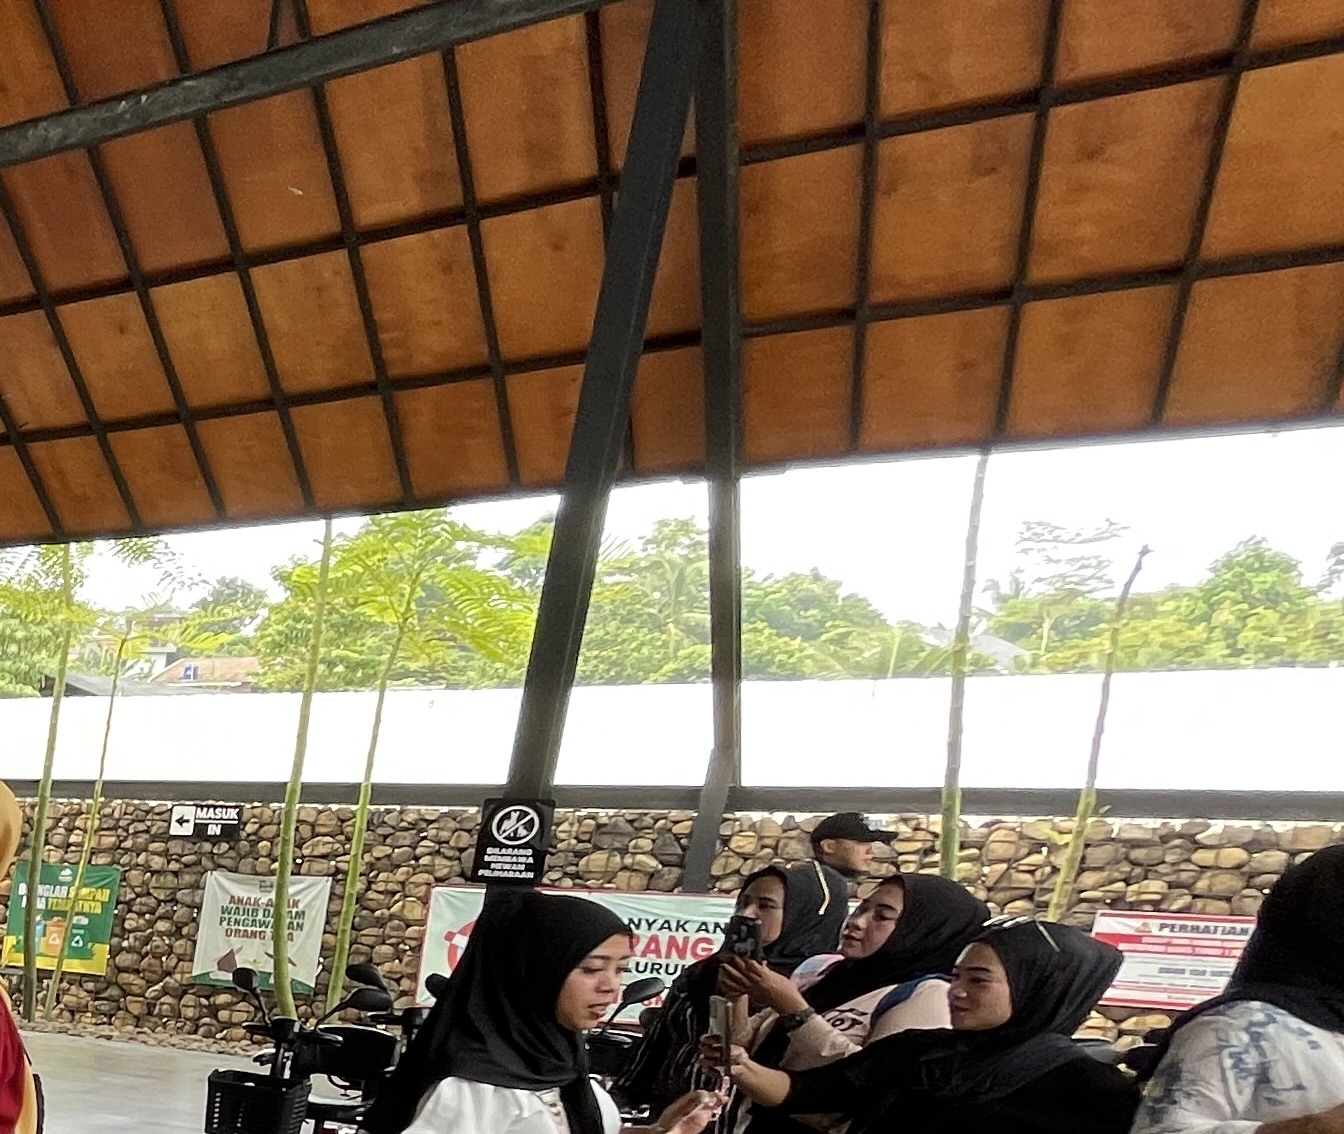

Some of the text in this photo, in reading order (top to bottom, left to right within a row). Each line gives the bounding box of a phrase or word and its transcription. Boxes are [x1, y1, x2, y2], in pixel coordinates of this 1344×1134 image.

[196, 807, 239, 820] MASUK
[207, 824, 222, 836] IN
[18, 883, 110, 902] BNGLAH SMPAH
[229, 895, 301, 909] ANAK-AK
[221, 905, 306, 921] WAJIB DAM
[219, 916, 305, 932] PENGAWAN
[628, 917, 689, 933] NYAK
[1159, 922, 1251, 937] PERHATIAN
[225, 928, 267, 941] ORANG
[628, 934, 715, 961] RANG
